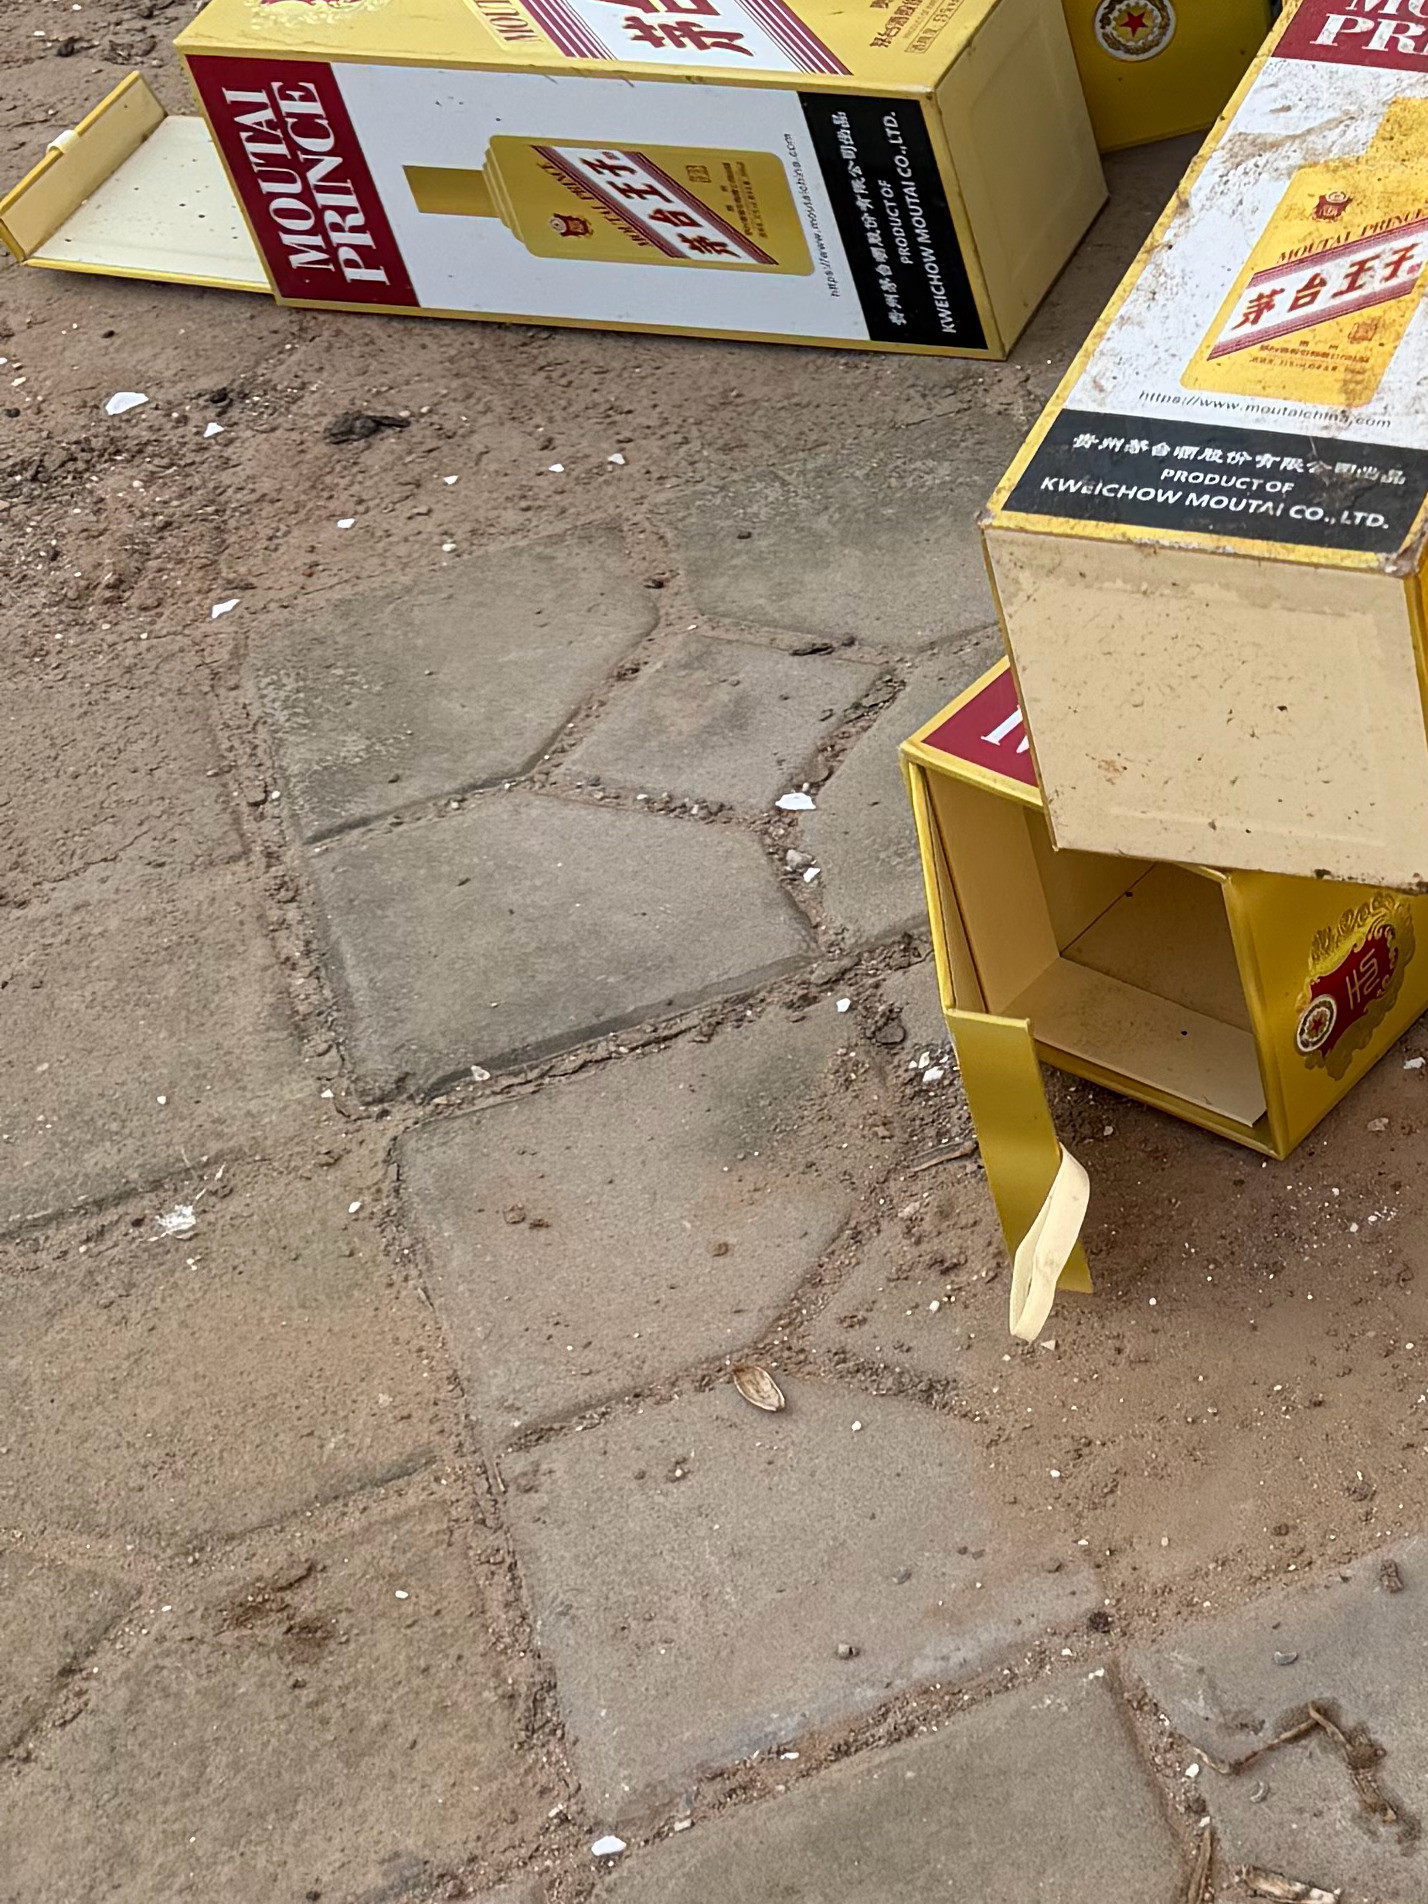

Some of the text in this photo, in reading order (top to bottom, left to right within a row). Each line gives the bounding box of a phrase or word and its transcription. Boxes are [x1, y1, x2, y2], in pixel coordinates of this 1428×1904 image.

[221, 87, 336, 272] MOUTAI
[270, 81, 389, 283] PRINCE
[579, 155, 741, 258] 茅台王子
[877, 179, 914, 265] PRODUCT OF
[902, 186, 932, 244] MOUTAI
[919, 247, 957, 334] KWEICHOW
[1231, 242, 1420, 330] 茅台王子
[1040, 476, 1183, 504] KWEICHOW
[1184, 492, 1285, 517] MOUTAI
[1160, 468, 1295, 494] PRODUCT OF
